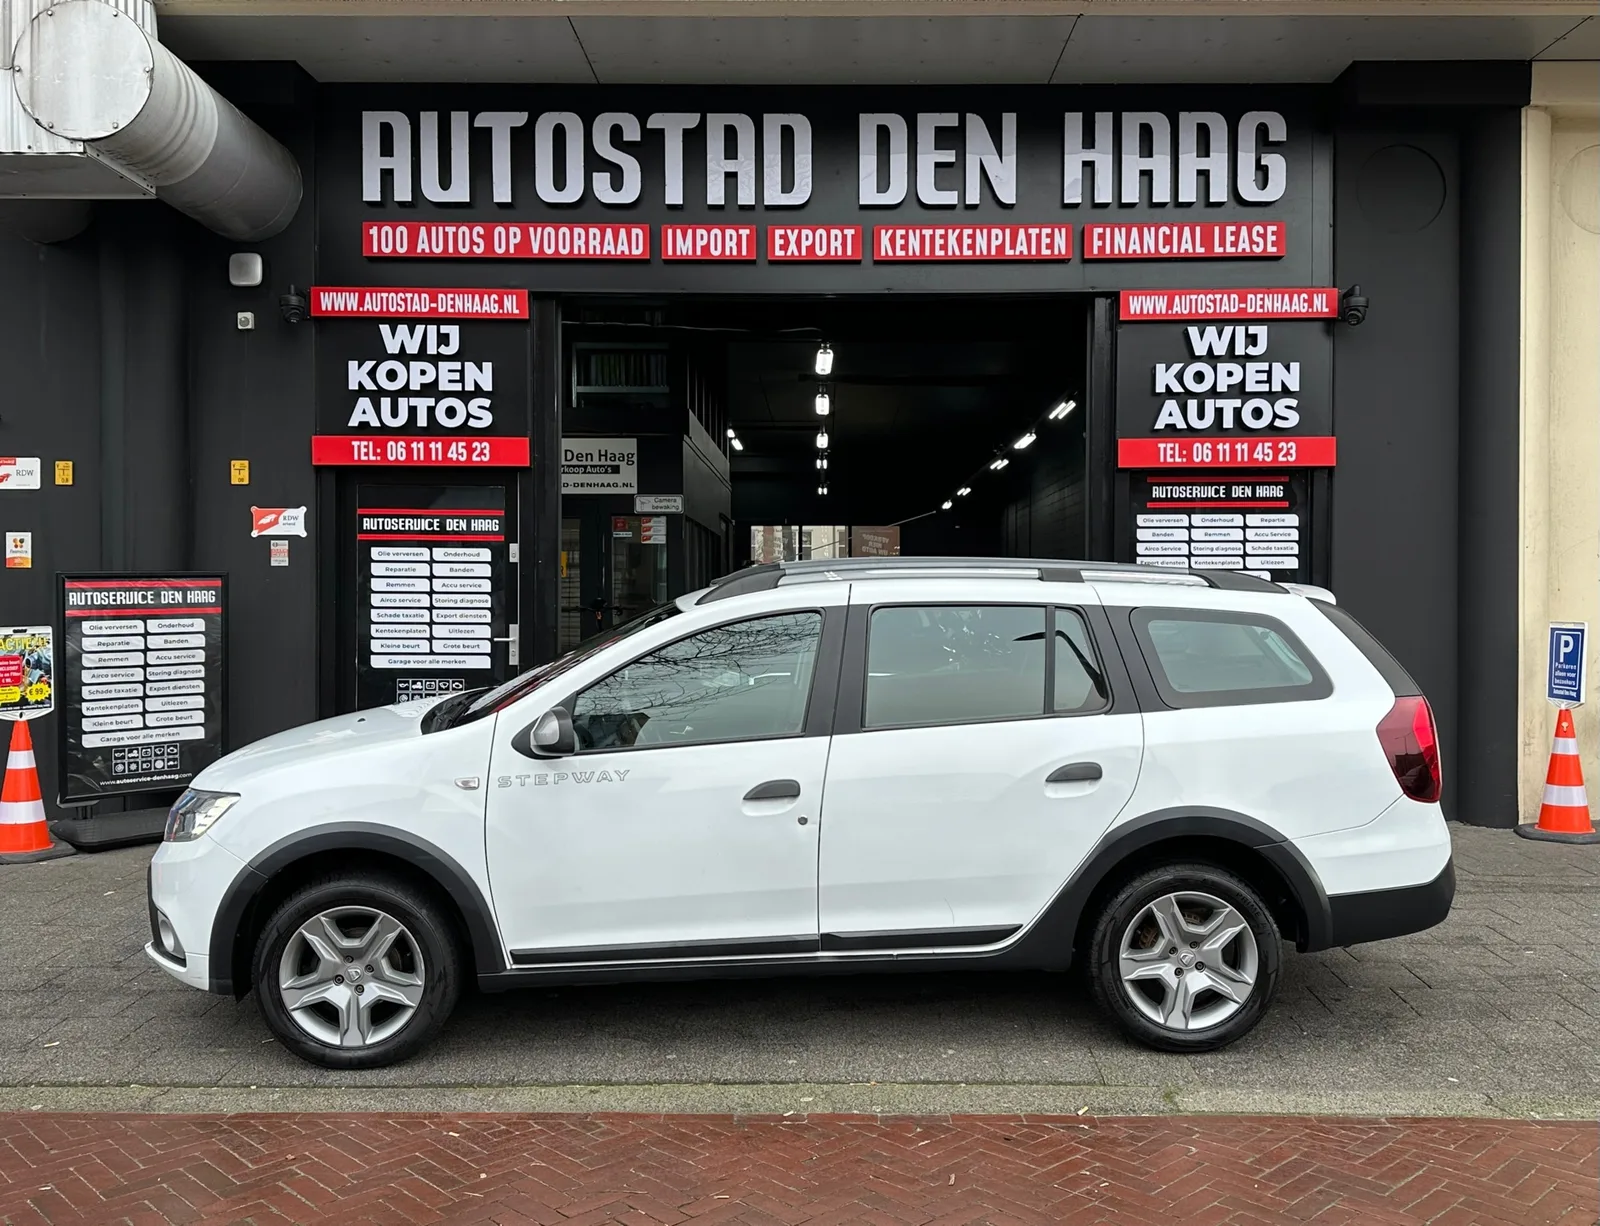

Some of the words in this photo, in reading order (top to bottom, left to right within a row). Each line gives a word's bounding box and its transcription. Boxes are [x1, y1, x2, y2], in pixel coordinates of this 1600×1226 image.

[362, 111, 812, 206] AUTOSTAD
[859, 113, 1017, 205] DEN
[1064, 112, 1288, 204] HAAG
[368, 226, 408, 254] 100
[417, 226, 485, 254] AUTOS
[493, 227, 521, 254] OP
[529, 227, 645, 256] VOORRAAD
[666, 228, 750, 256] IMPORT
[773, 227, 856, 257] EXPORT
[880, 229, 1067, 256] KENTEKENPLATEN
[1092, 226, 1206, 255] FINANCIAL
[1213, 226, 1278, 254] LEASE
[320, 293, 520, 314] WWW.AUTOSTAD-DENHAAG.NL
[1128, 294, 1329, 315] WWW.AUTOSTAD-DENHAAG.NL
[379, 325, 460, 355] WIJ
[1185, 326, 1268, 356] WIJ
[348, 362, 493, 392] KOPEN
[1154, 362, 1300, 393] KOPEN
[348, 398, 493, 428] AUTOS
[1154, 398, 1300, 429] AUTOS
[352, 442, 381, 461] TEL:
[387, 442, 406, 461] 06
[411, 442, 426, 461] 11
[430, 442, 443, 461] 11
[448, 442, 467, 461] 45
[472, 442, 490, 461] 23
[564, 449, 593, 462] Den
[598, 449, 635, 465] Haag
[1158, 442, 1186, 463] TEL:
[1192, 442, 1212, 462] 06
[1216, 442, 1230, 462] 11
[1235, 442, 1249, 462] 11
[1253, 442, 1274, 462] 45
[1278, 442, 1296, 461] 23
[1152, 486, 1225, 498] AUTOSERVICE
[1232, 486, 1251, 497] DEN
[1256, 485, 1283, 497] HAAG
[363, 518, 440, 531] AUTOSERVICE
[446, 519, 466, 531] DEN
[471, 519, 499, 531] HAAG
[69, 591, 154, 605] AUTOSERVICE
[161, 591, 182, 604] DEN
[187, 590, 215, 603] HAAG
[1560, 635, 1573, 662] P
[86, 703, 139, 712] Kentekenplaten
[100, 735, 124, 743] Garage
[497, 770, 630, 788] STEPWAY
